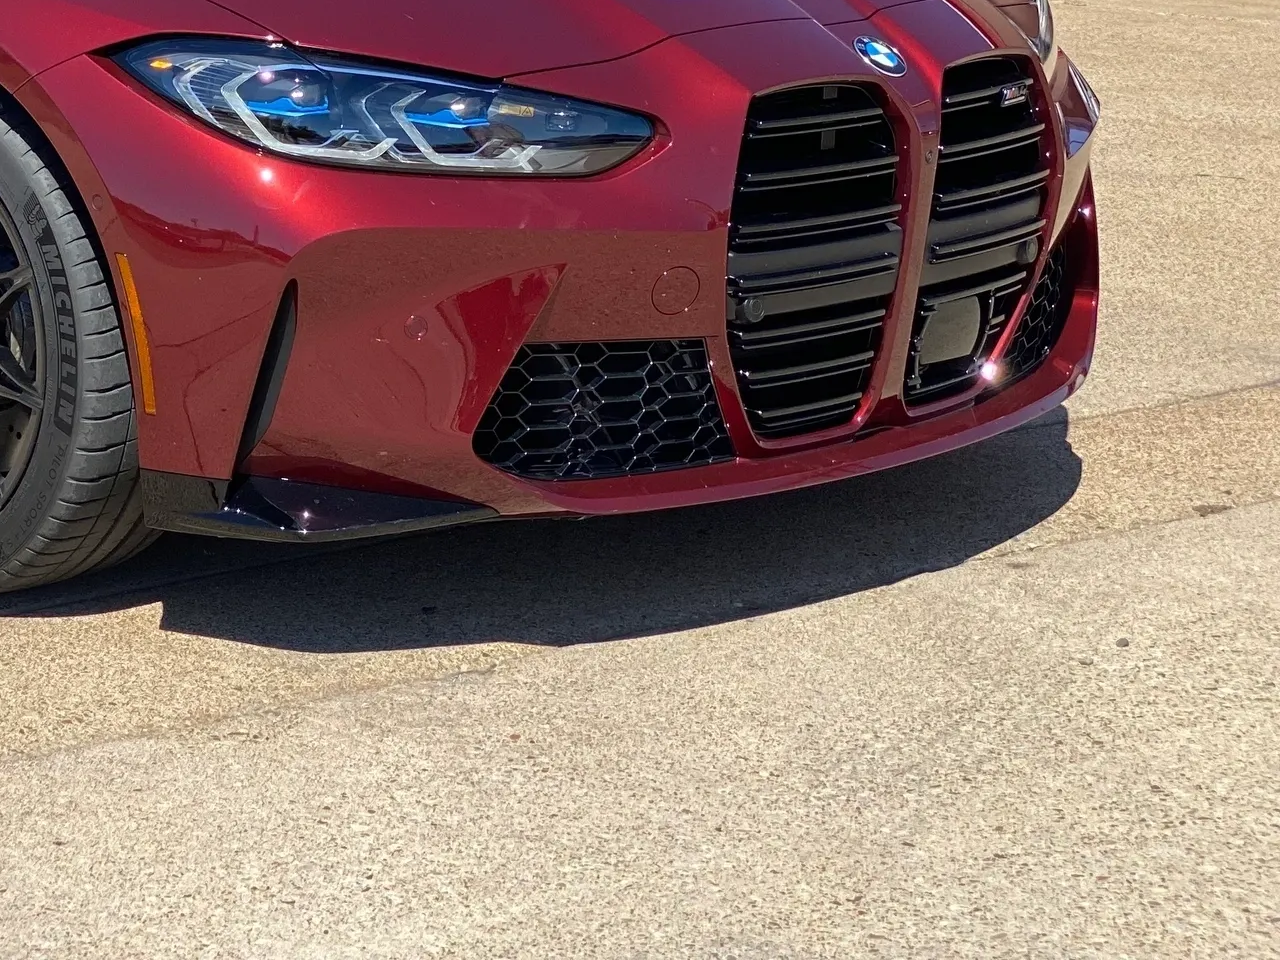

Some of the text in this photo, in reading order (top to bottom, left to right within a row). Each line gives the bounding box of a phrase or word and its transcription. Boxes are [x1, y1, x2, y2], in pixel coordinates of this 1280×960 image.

[42, 243, 77, 429] MICHELIN
[46, 444, 69, 488] PILOT
[20, 491, 48, 536] SPORT
